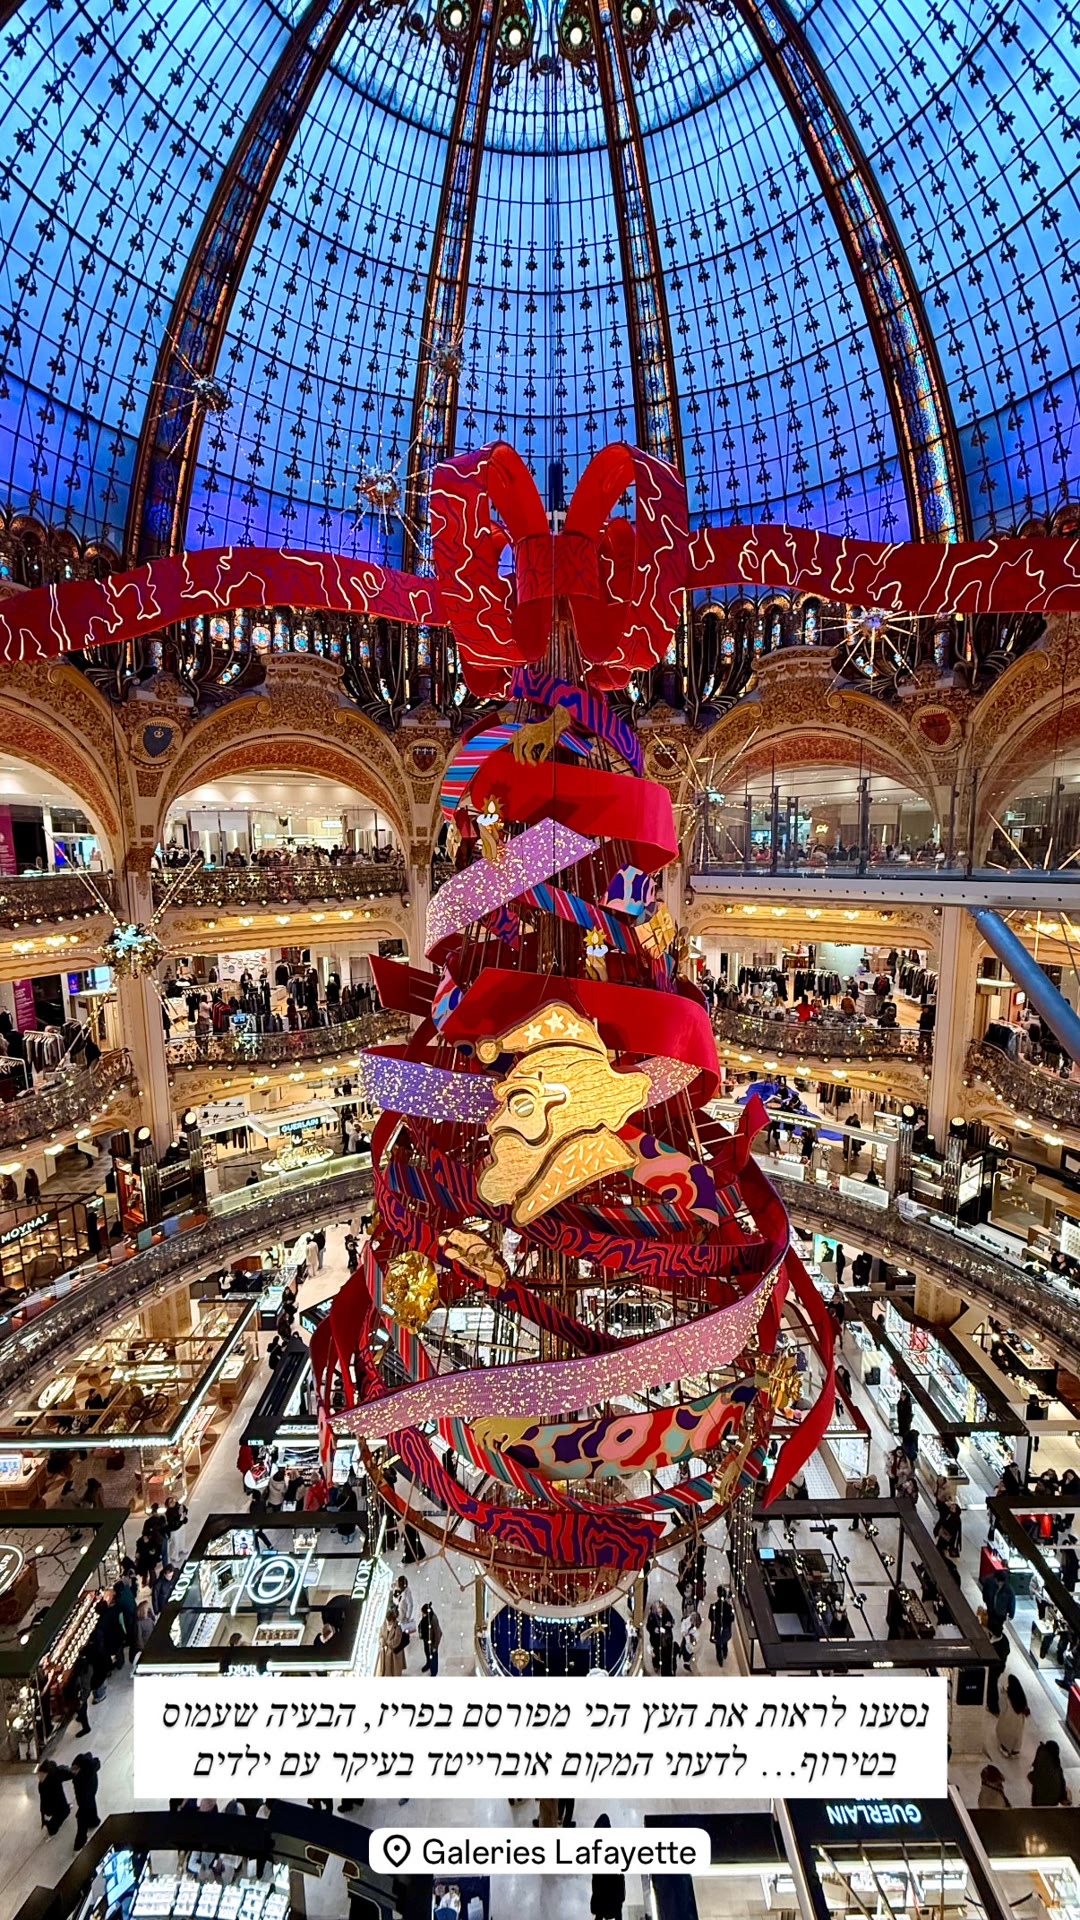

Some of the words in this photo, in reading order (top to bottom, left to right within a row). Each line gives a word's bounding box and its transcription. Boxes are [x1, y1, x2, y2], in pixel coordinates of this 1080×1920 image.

[281, 1118, 319, 1132] GUERLAIN
[1, 1213, 48, 1243] MOYNAT
[168, 1561, 198, 1602] DIOR
[352, 1559, 374, 1600] DIOR
[826, 1804, 922, 1824] GUERLAIN
